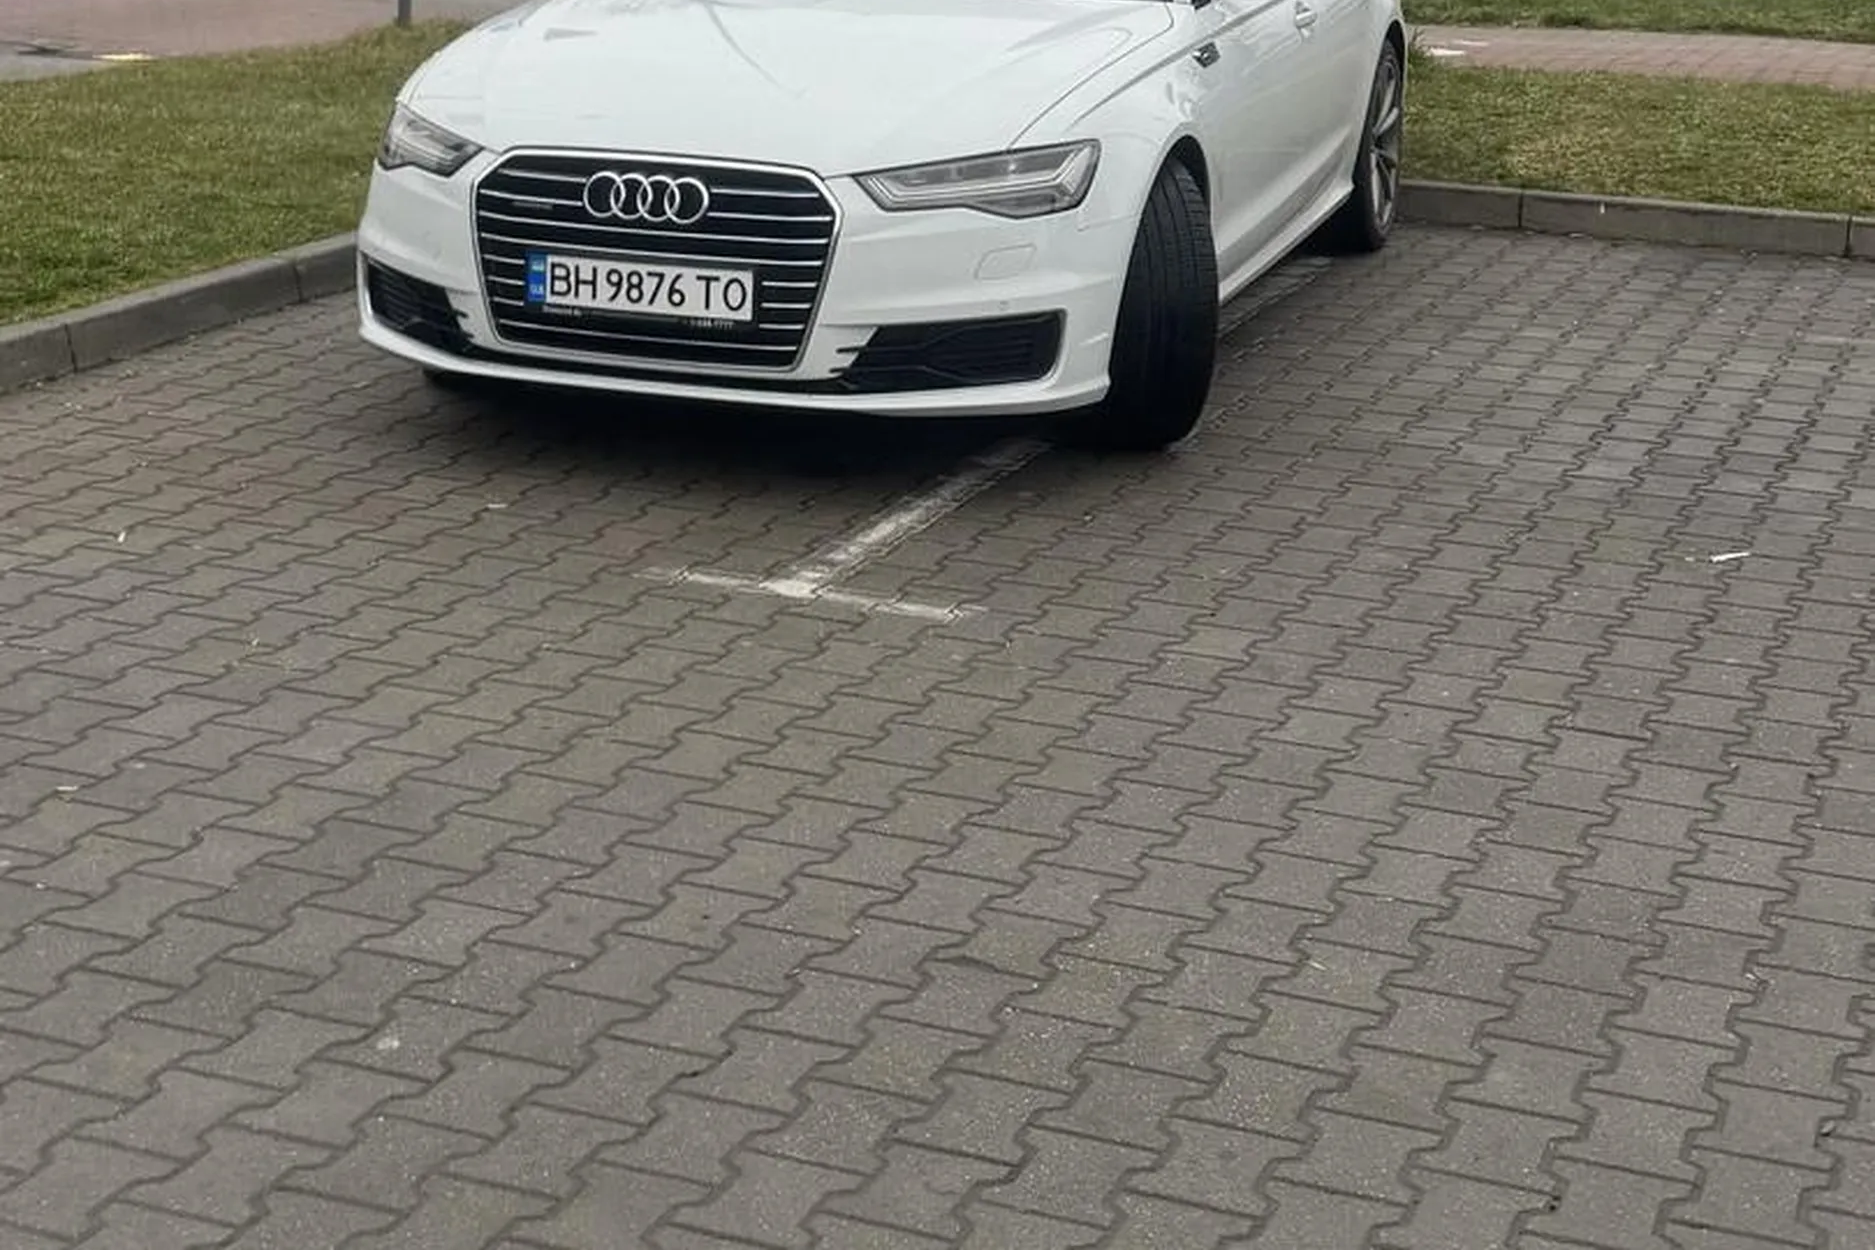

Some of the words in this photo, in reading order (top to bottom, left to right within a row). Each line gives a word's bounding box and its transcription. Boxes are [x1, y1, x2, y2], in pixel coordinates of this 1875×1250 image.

[550, 261, 598, 301] BH
[605, 268, 686, 307] 9876
[695, 274, 748, 312] TO
